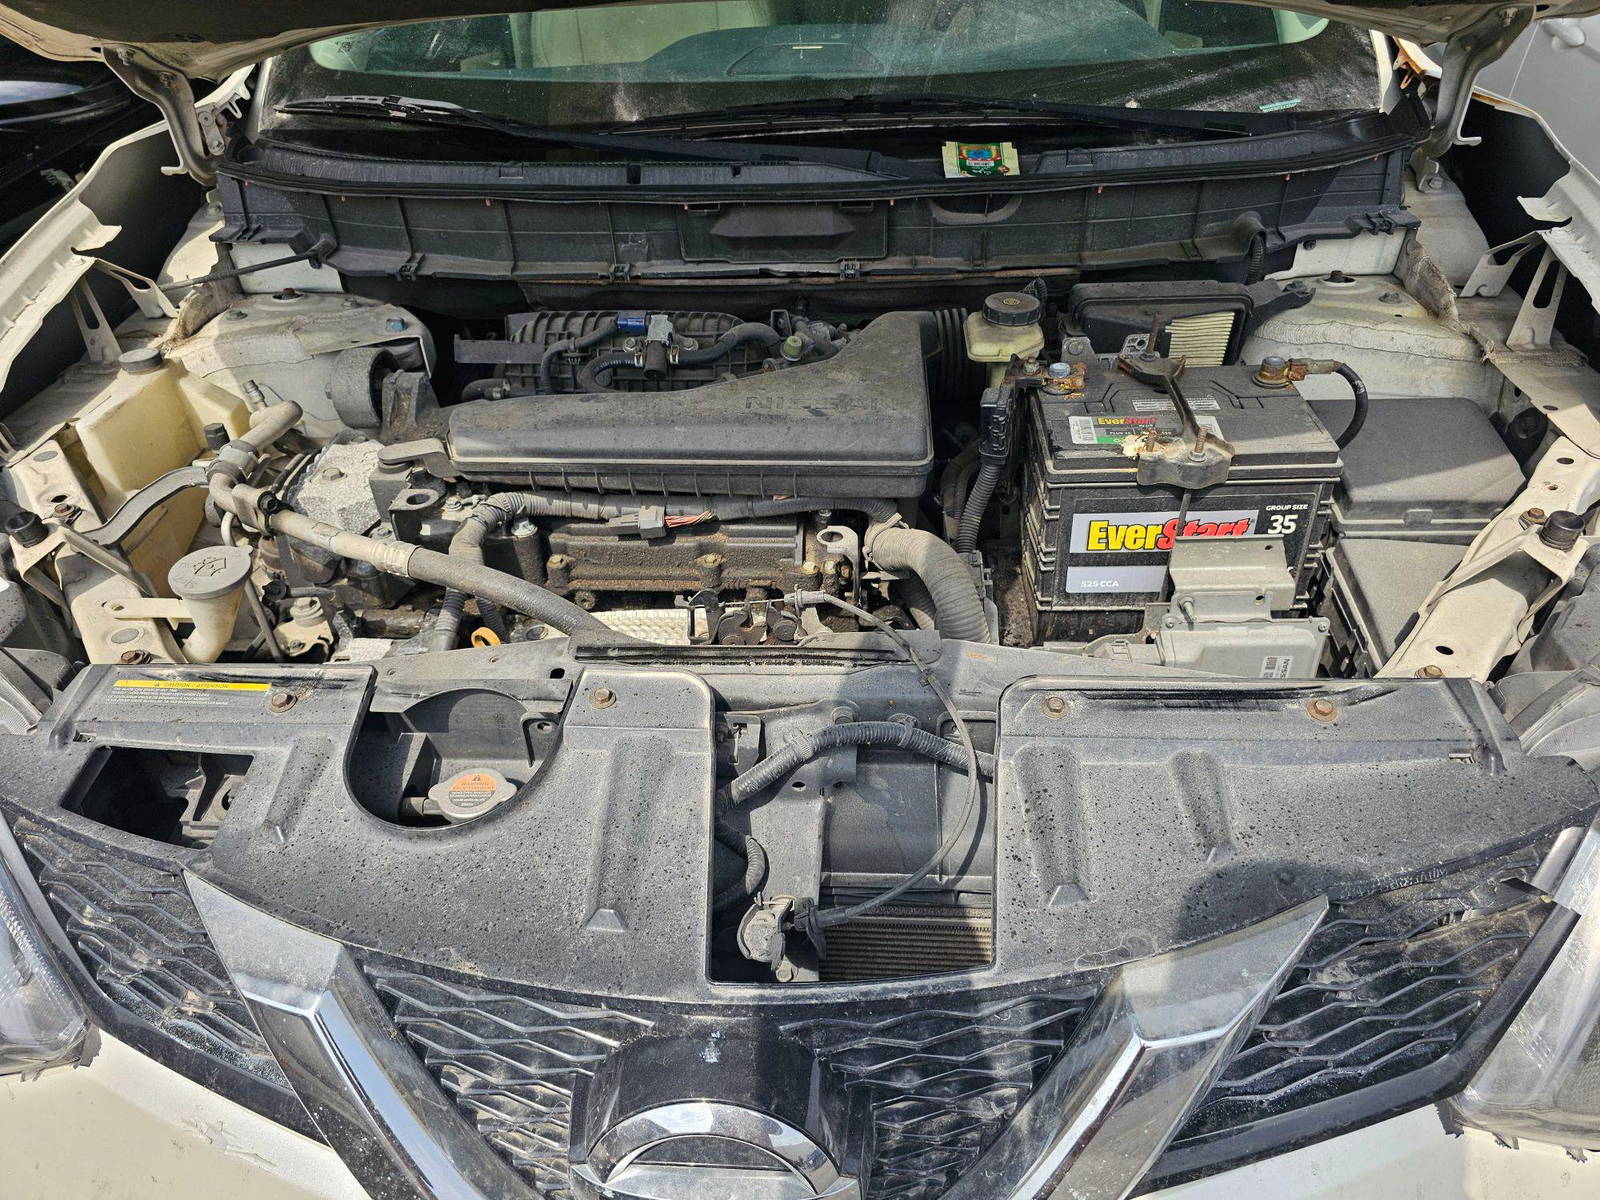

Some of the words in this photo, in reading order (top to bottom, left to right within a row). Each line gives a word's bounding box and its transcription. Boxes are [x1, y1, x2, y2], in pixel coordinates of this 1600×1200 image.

[1097, 416, 1158, 425] EverStart
[1267, 514, 1299, 535] 35
[1086, 517, 1251, 551] EverStart
[1080, 580, 1099, 588] 525
[1099, 580, 1120, 588] CCA
